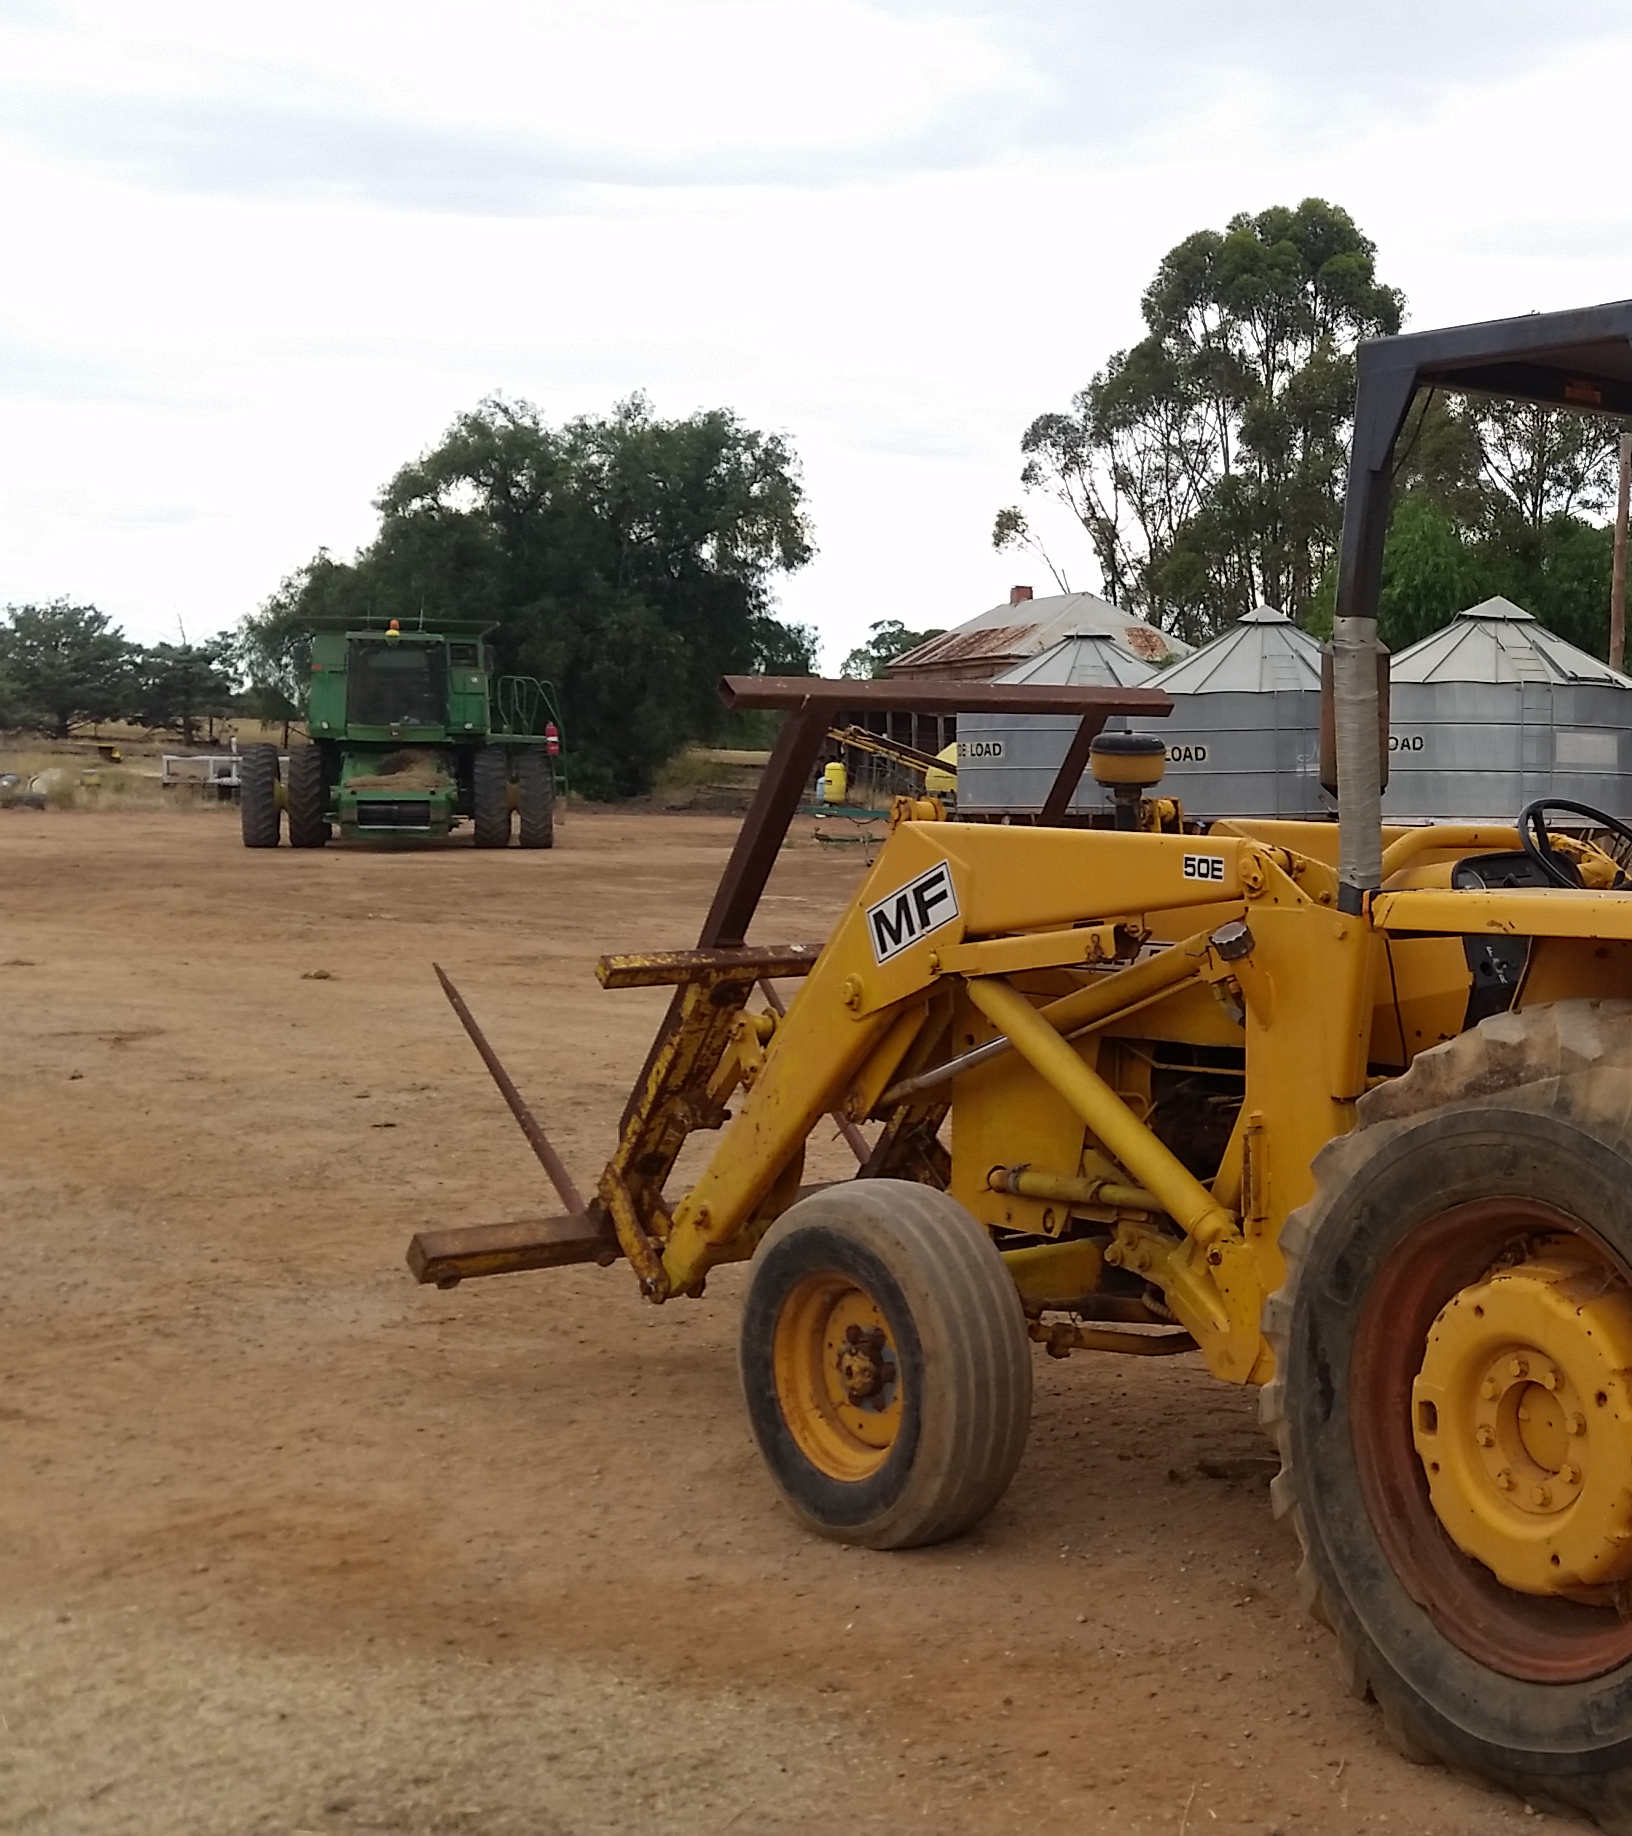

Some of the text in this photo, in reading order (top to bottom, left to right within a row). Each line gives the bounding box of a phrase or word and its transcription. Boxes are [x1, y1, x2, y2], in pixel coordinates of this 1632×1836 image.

[971, 743, 1002, 757] LOAD
[1184, 856, 1224, 880] 50E
[872, 870, 949, 955] MF
